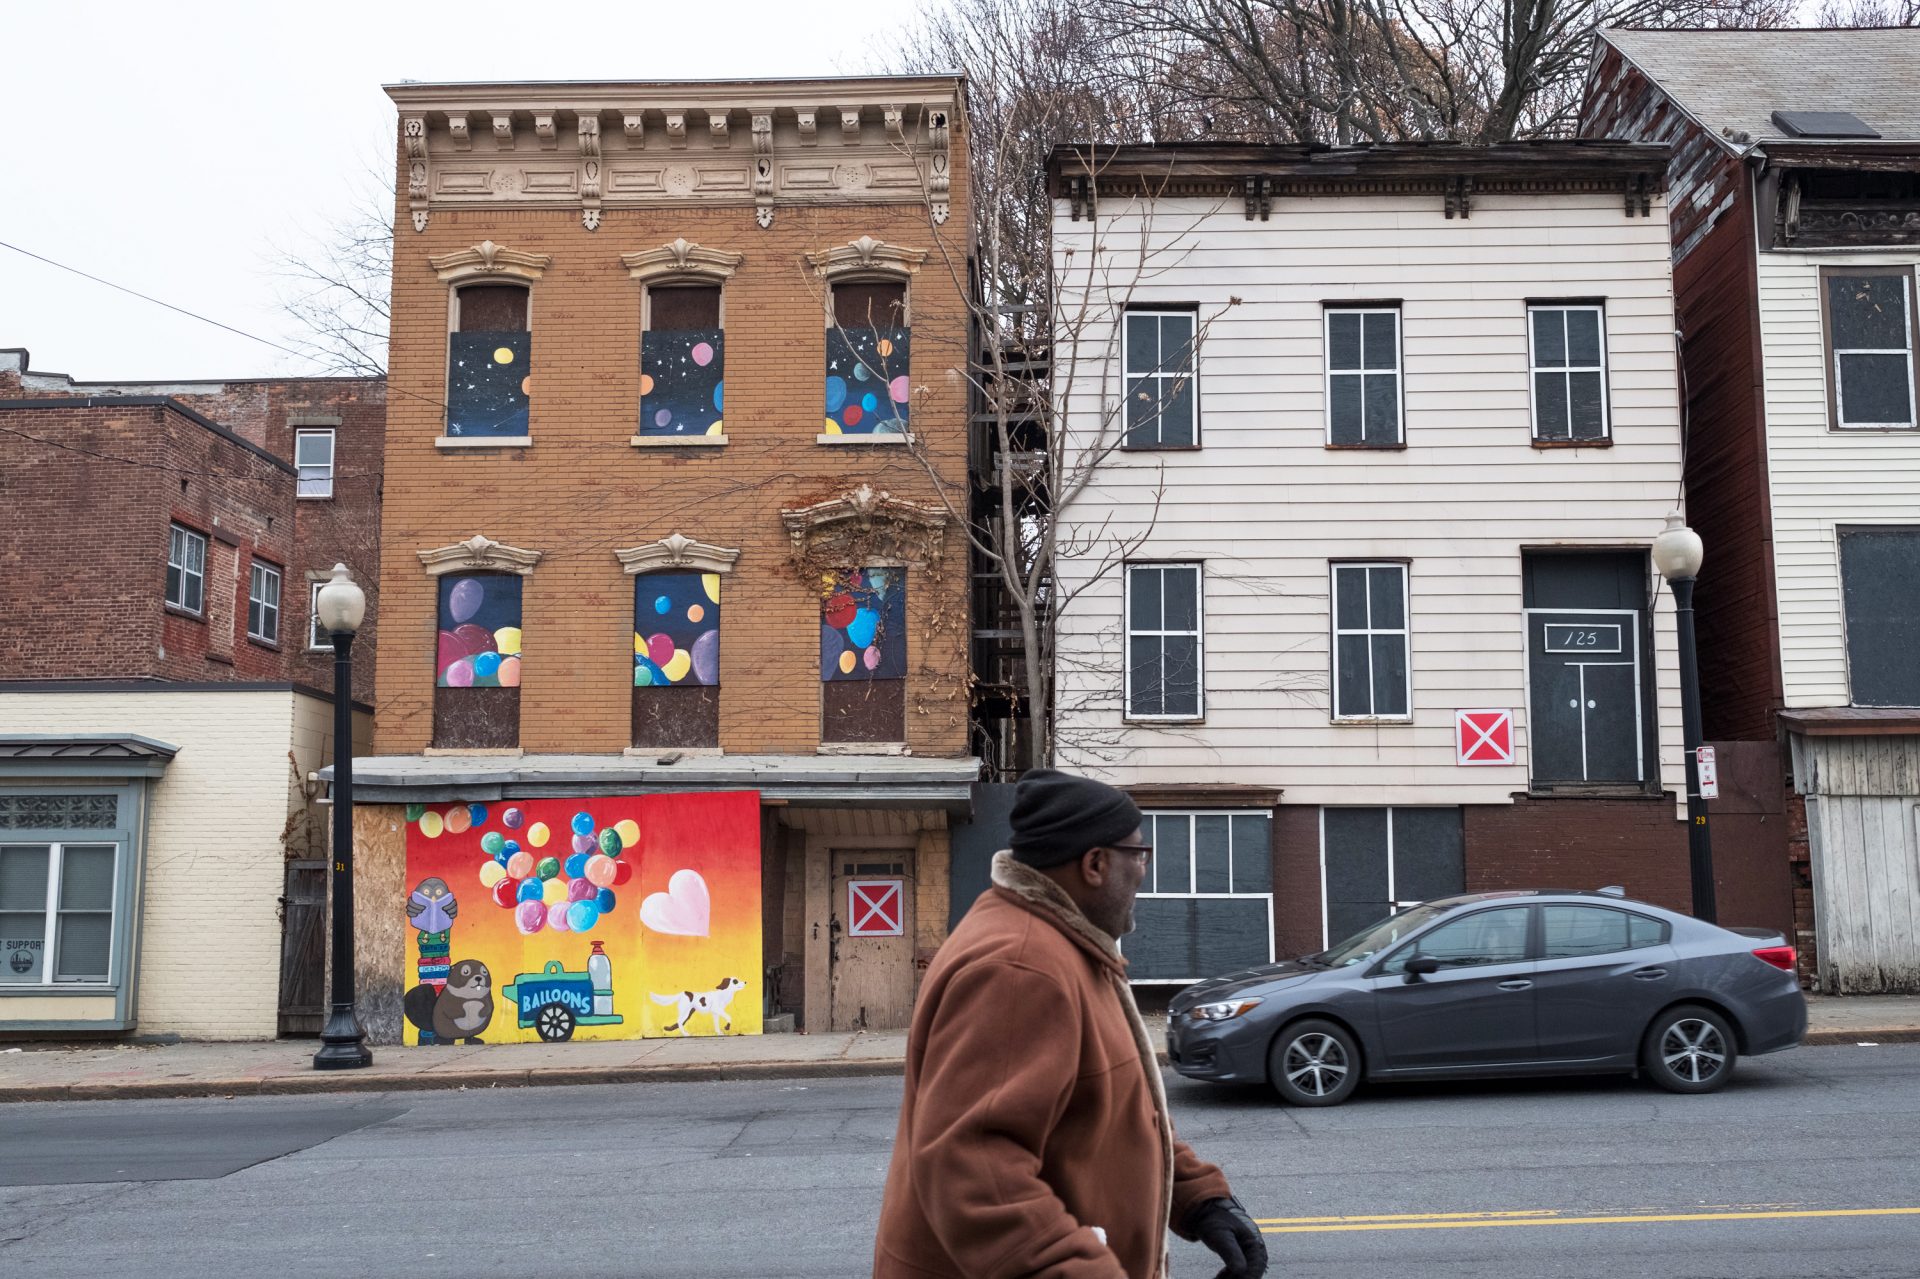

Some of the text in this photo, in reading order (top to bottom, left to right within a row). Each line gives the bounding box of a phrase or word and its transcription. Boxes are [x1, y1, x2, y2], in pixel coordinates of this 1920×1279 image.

[1564, 631, 1597, 646] 125
[1695, 815, 1706, 825] 29
[523, 988, 591, 1014] BALLOONS
